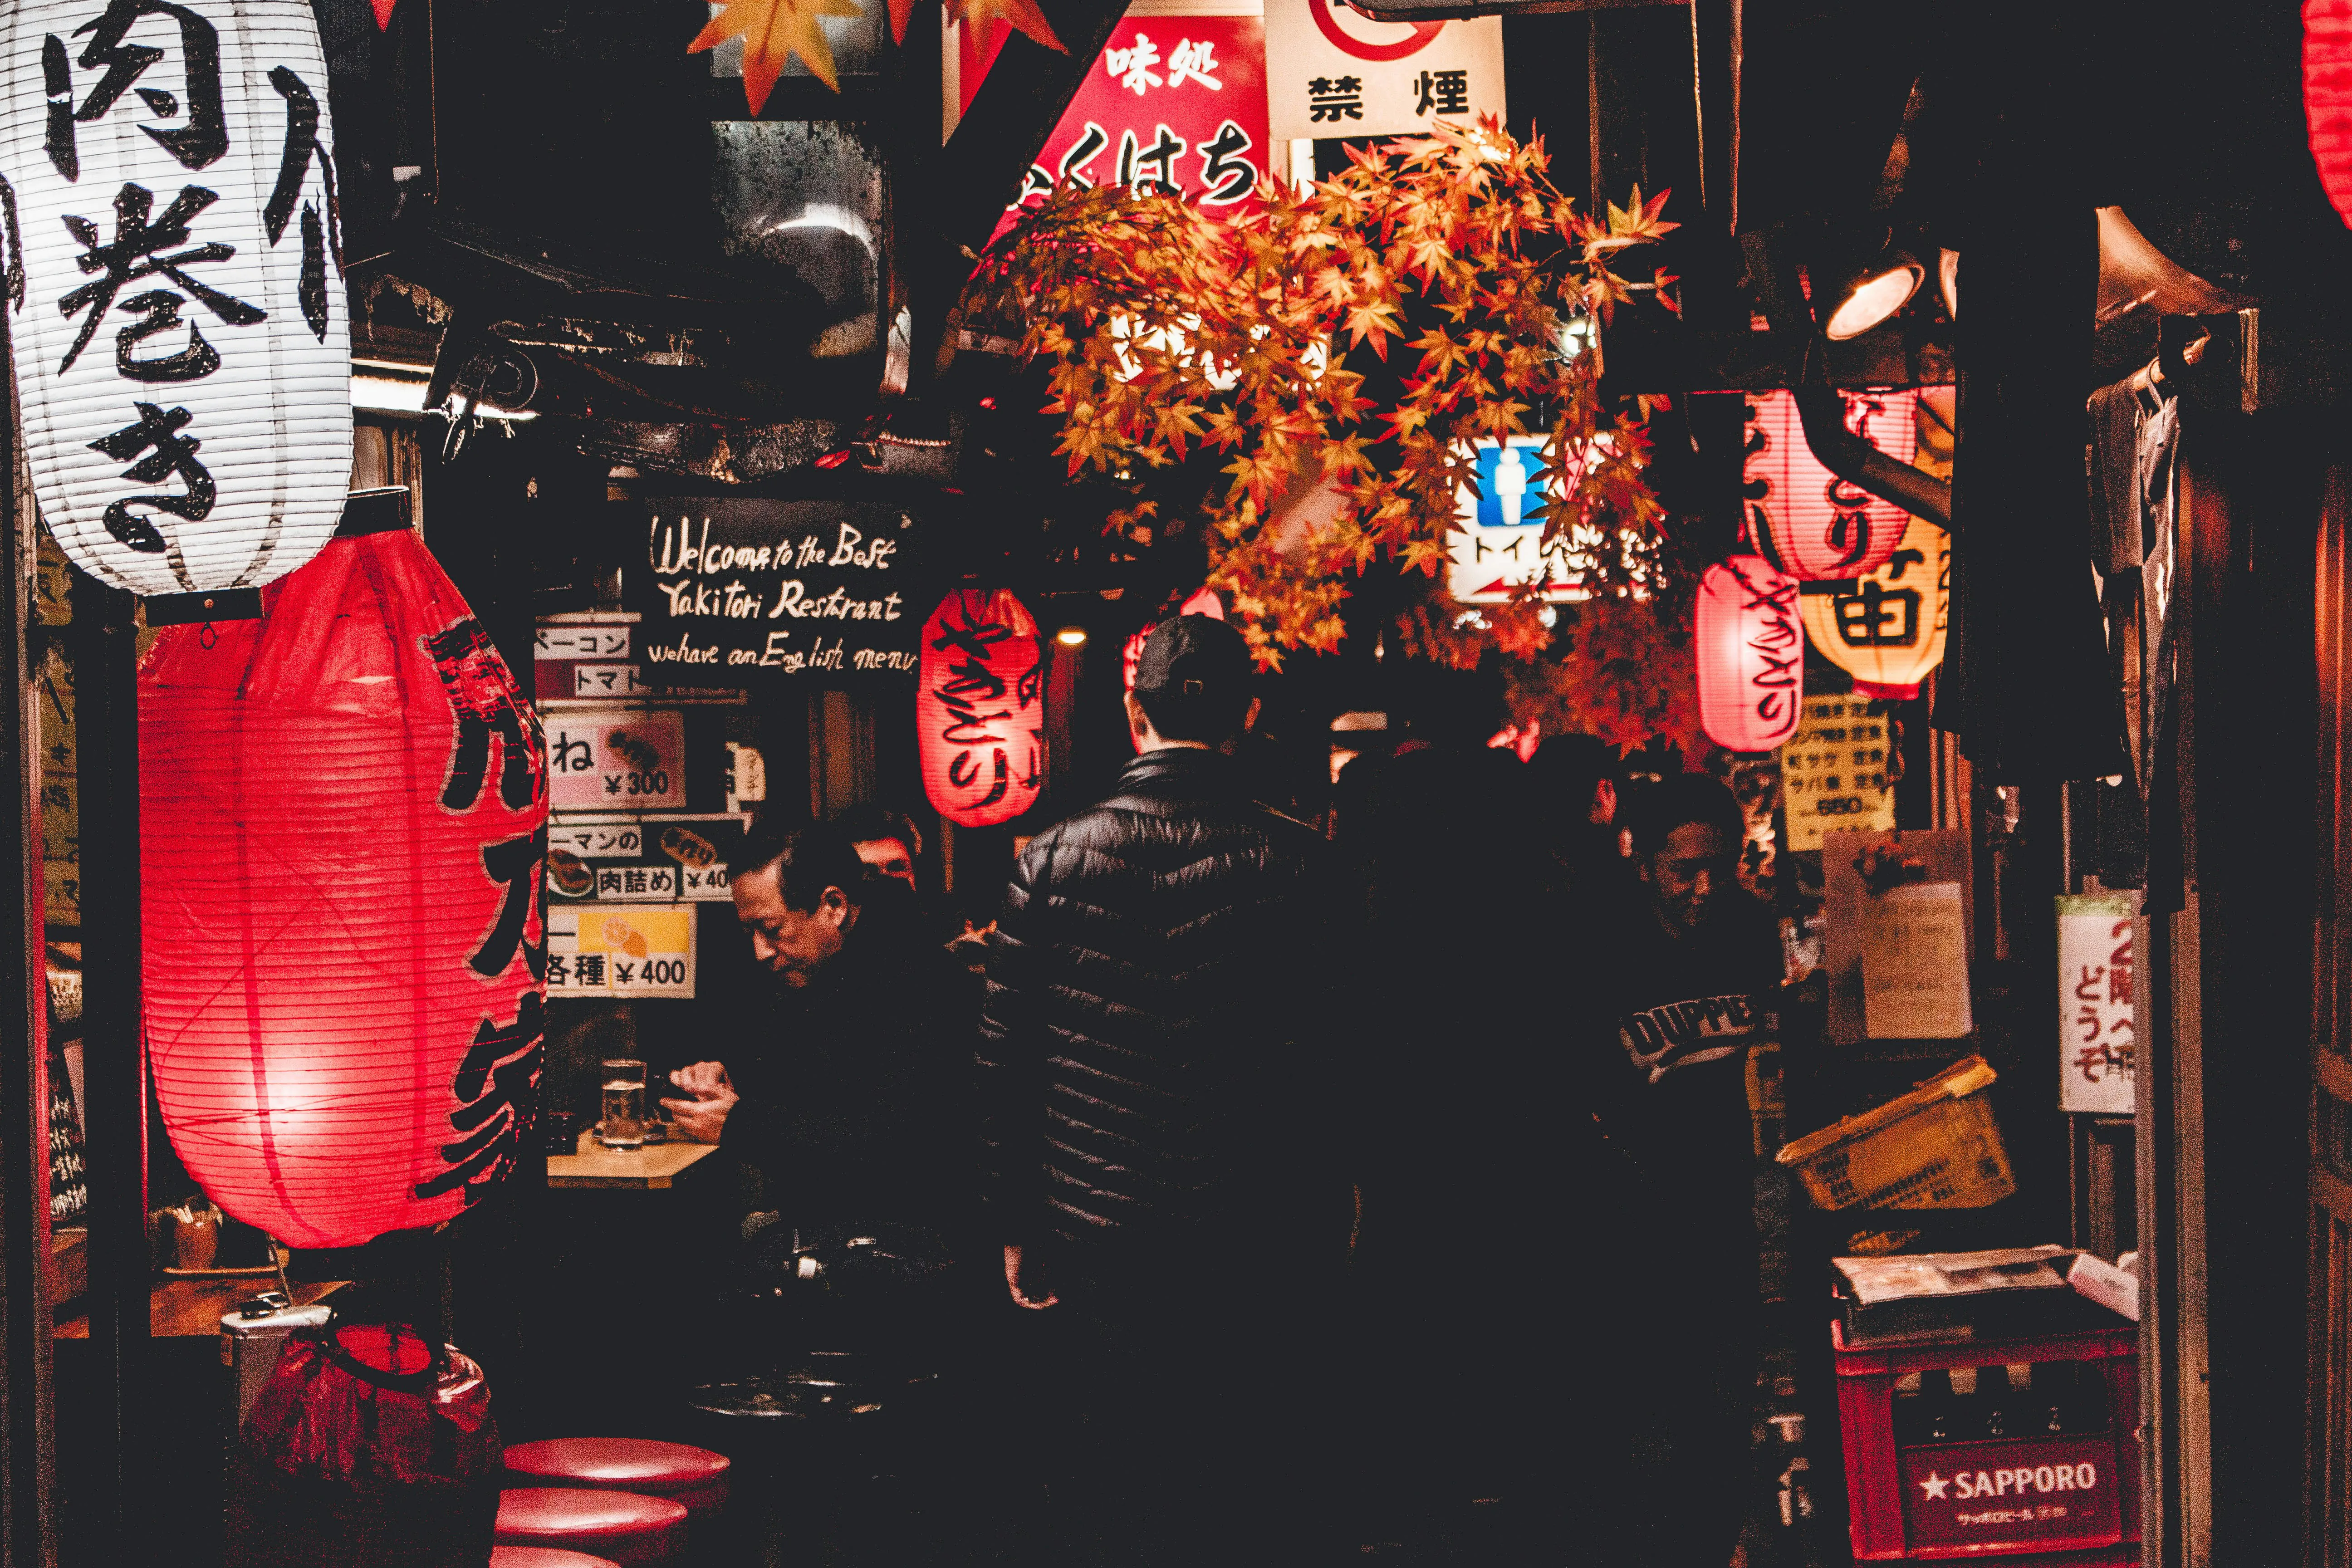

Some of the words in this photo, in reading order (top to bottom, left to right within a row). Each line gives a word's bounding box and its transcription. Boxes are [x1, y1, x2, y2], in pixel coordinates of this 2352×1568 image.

[1105, 32, 1224, 96] 味処
[1308, 69, 1470, 123] 禁煙
[650, 515, 771, 575] Welcome
[772, 539, 794, 571] to
[795, 534, 826, 570] the
[828, 521, 897, 570] Best
[727, 648, 757, 666] an
[758, 630, 844, 675] English
[600, 870, 672, 894] 肉詰め
[547, 954, 606, 987] 各種
[615, 959, 686, 985] ¥400
[2073, 964, 2110, 1084] どうぞ
[1954, 1461, 2097, 1499] SAPPORO
